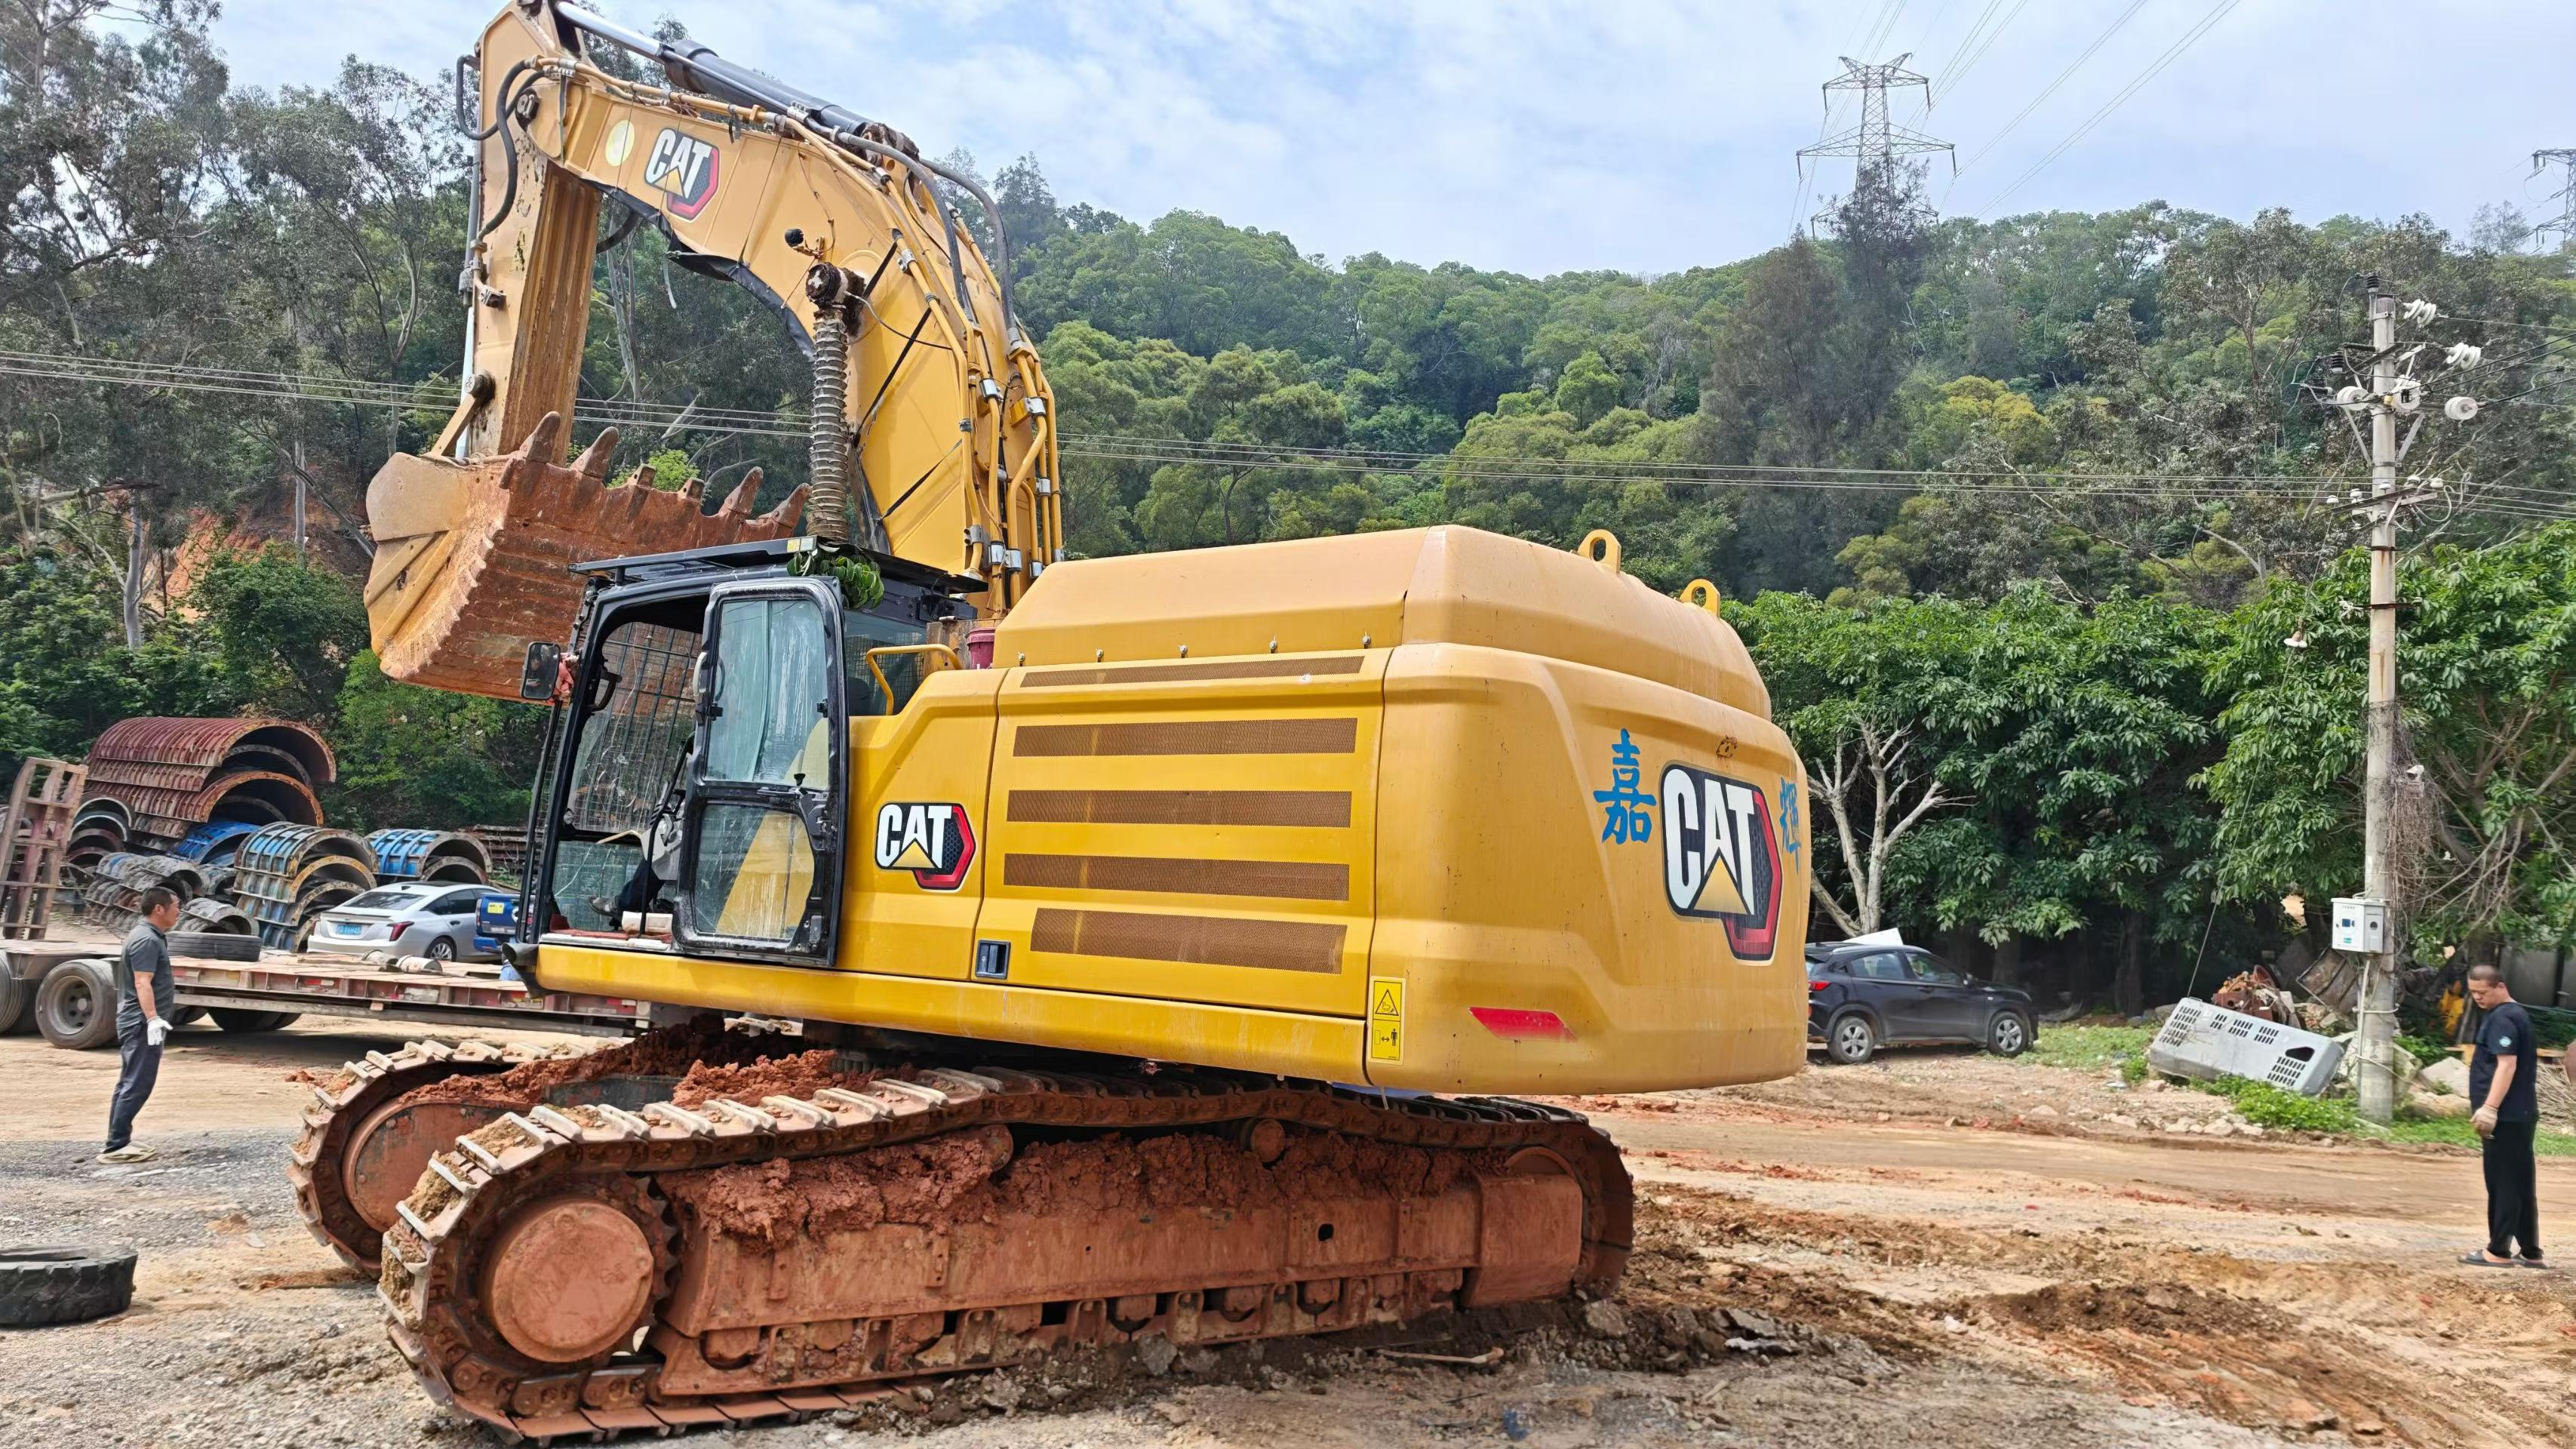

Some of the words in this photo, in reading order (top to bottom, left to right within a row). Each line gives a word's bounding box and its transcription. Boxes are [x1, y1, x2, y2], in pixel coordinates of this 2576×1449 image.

[645, 128, 712, 199] CAT
[1593, 728, 1657, 845] 嘉
[876, 804, 952, 869] CAT
[1663, 768, 1755, 915] CAT
